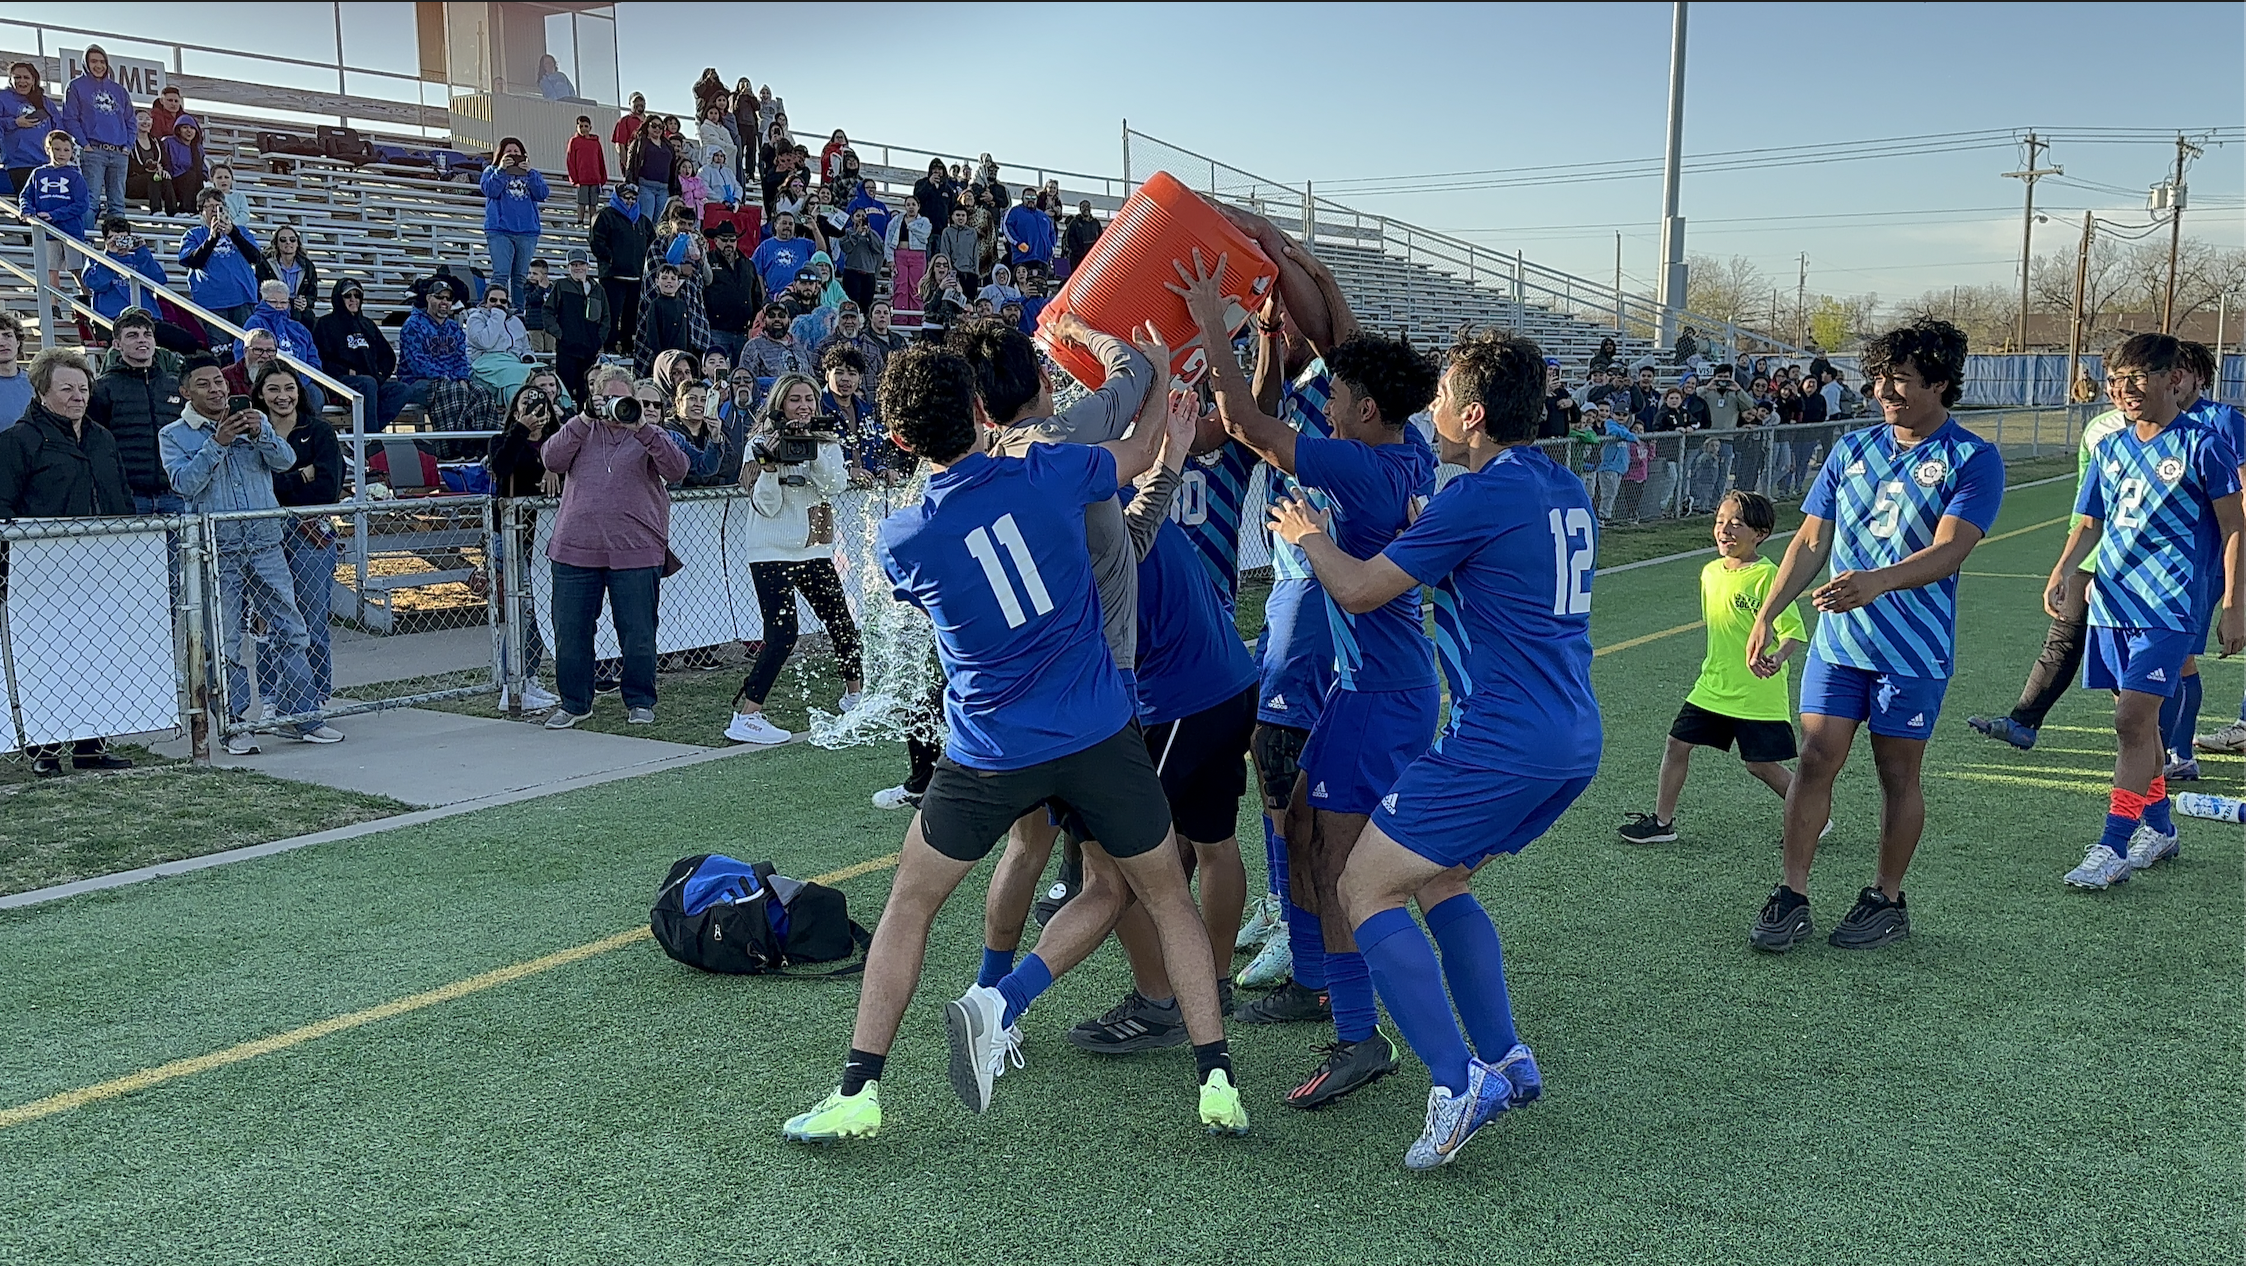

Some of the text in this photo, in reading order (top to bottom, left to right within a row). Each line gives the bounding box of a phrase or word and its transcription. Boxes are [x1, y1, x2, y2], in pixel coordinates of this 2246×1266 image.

[69, 58, 158, 96] HME
[1869, 481, 1905, 538] 5
[2113, 477, 2144, 528] 2
[964, 512, 1054, 630] 11
[1548, 507, 1594, 615] 12
